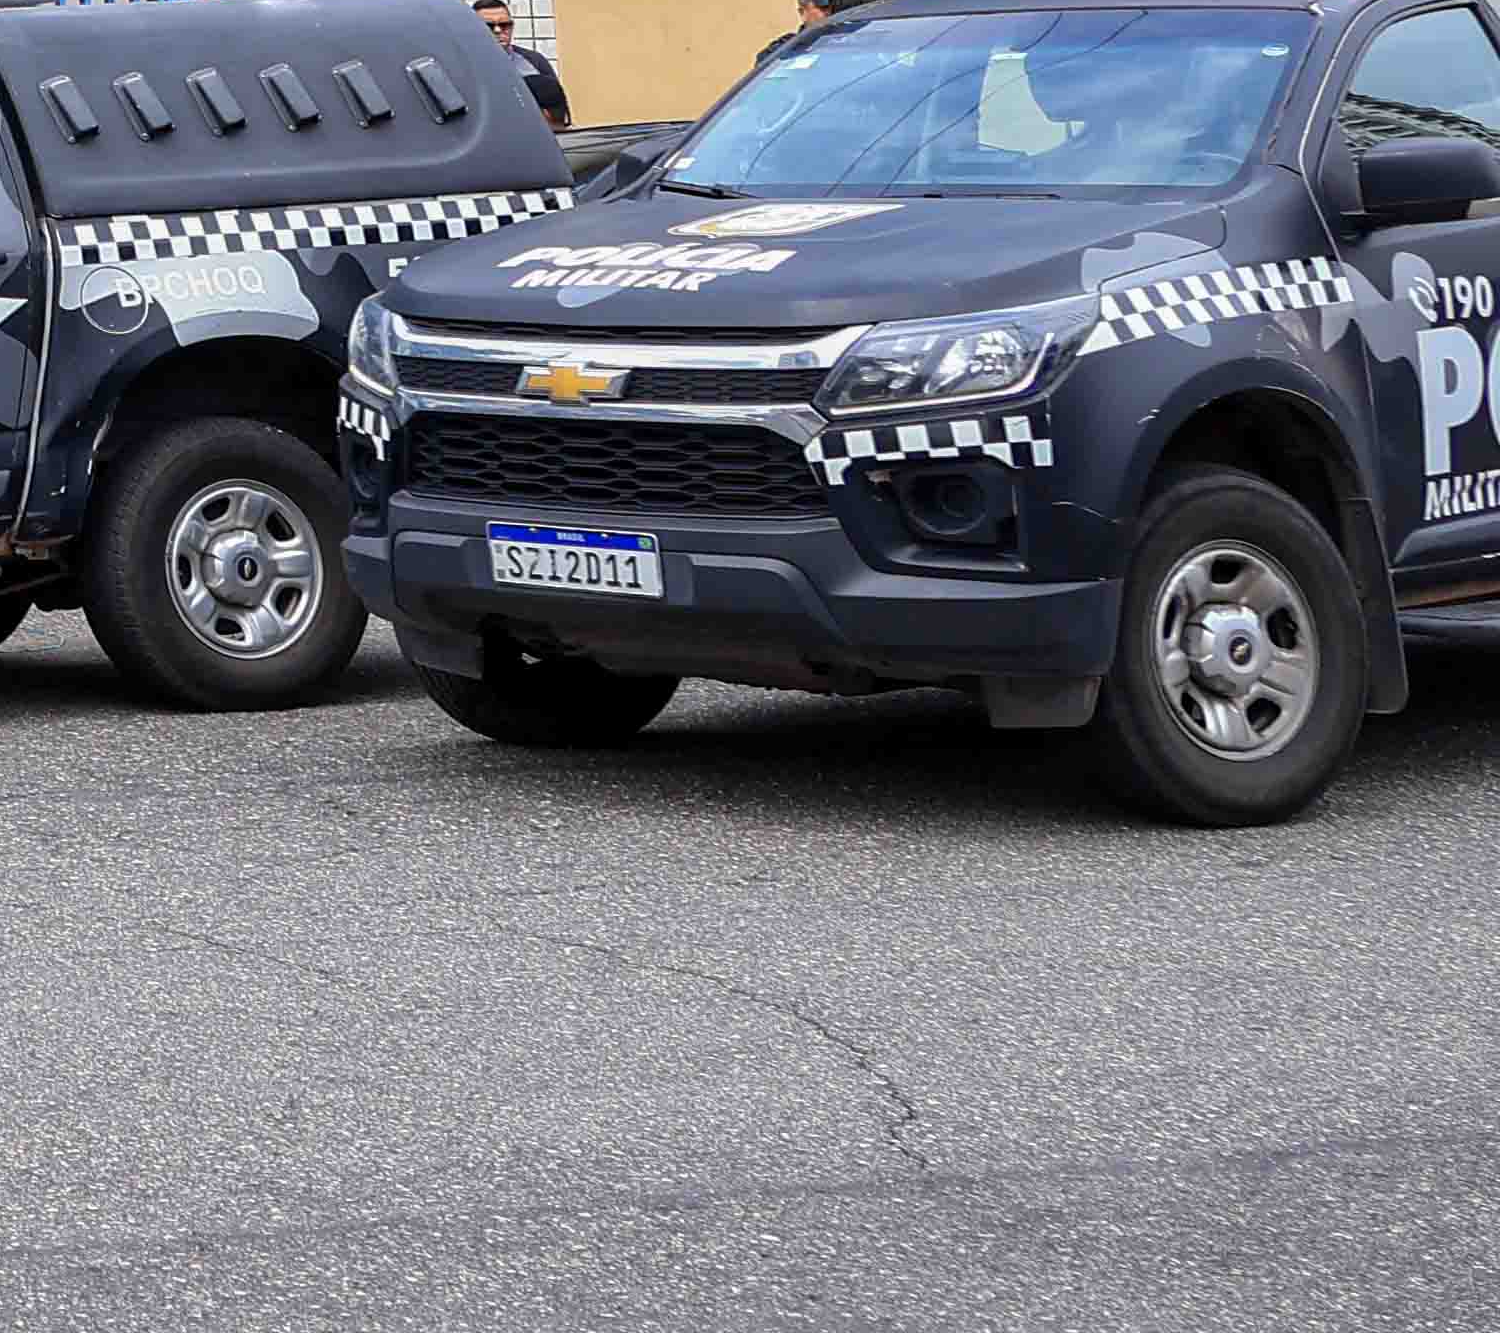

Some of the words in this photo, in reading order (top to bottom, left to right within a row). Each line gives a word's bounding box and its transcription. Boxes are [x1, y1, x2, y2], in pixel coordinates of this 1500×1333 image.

[496, 243, 797, 272] POLÍCIA
[115, 265, 267, 307] BPCHOQ
[510, 269, 717, 292] MILITAR
[1436, 275, 1494, 320] 190
[507, 545, 642, 589] SZI2D11
